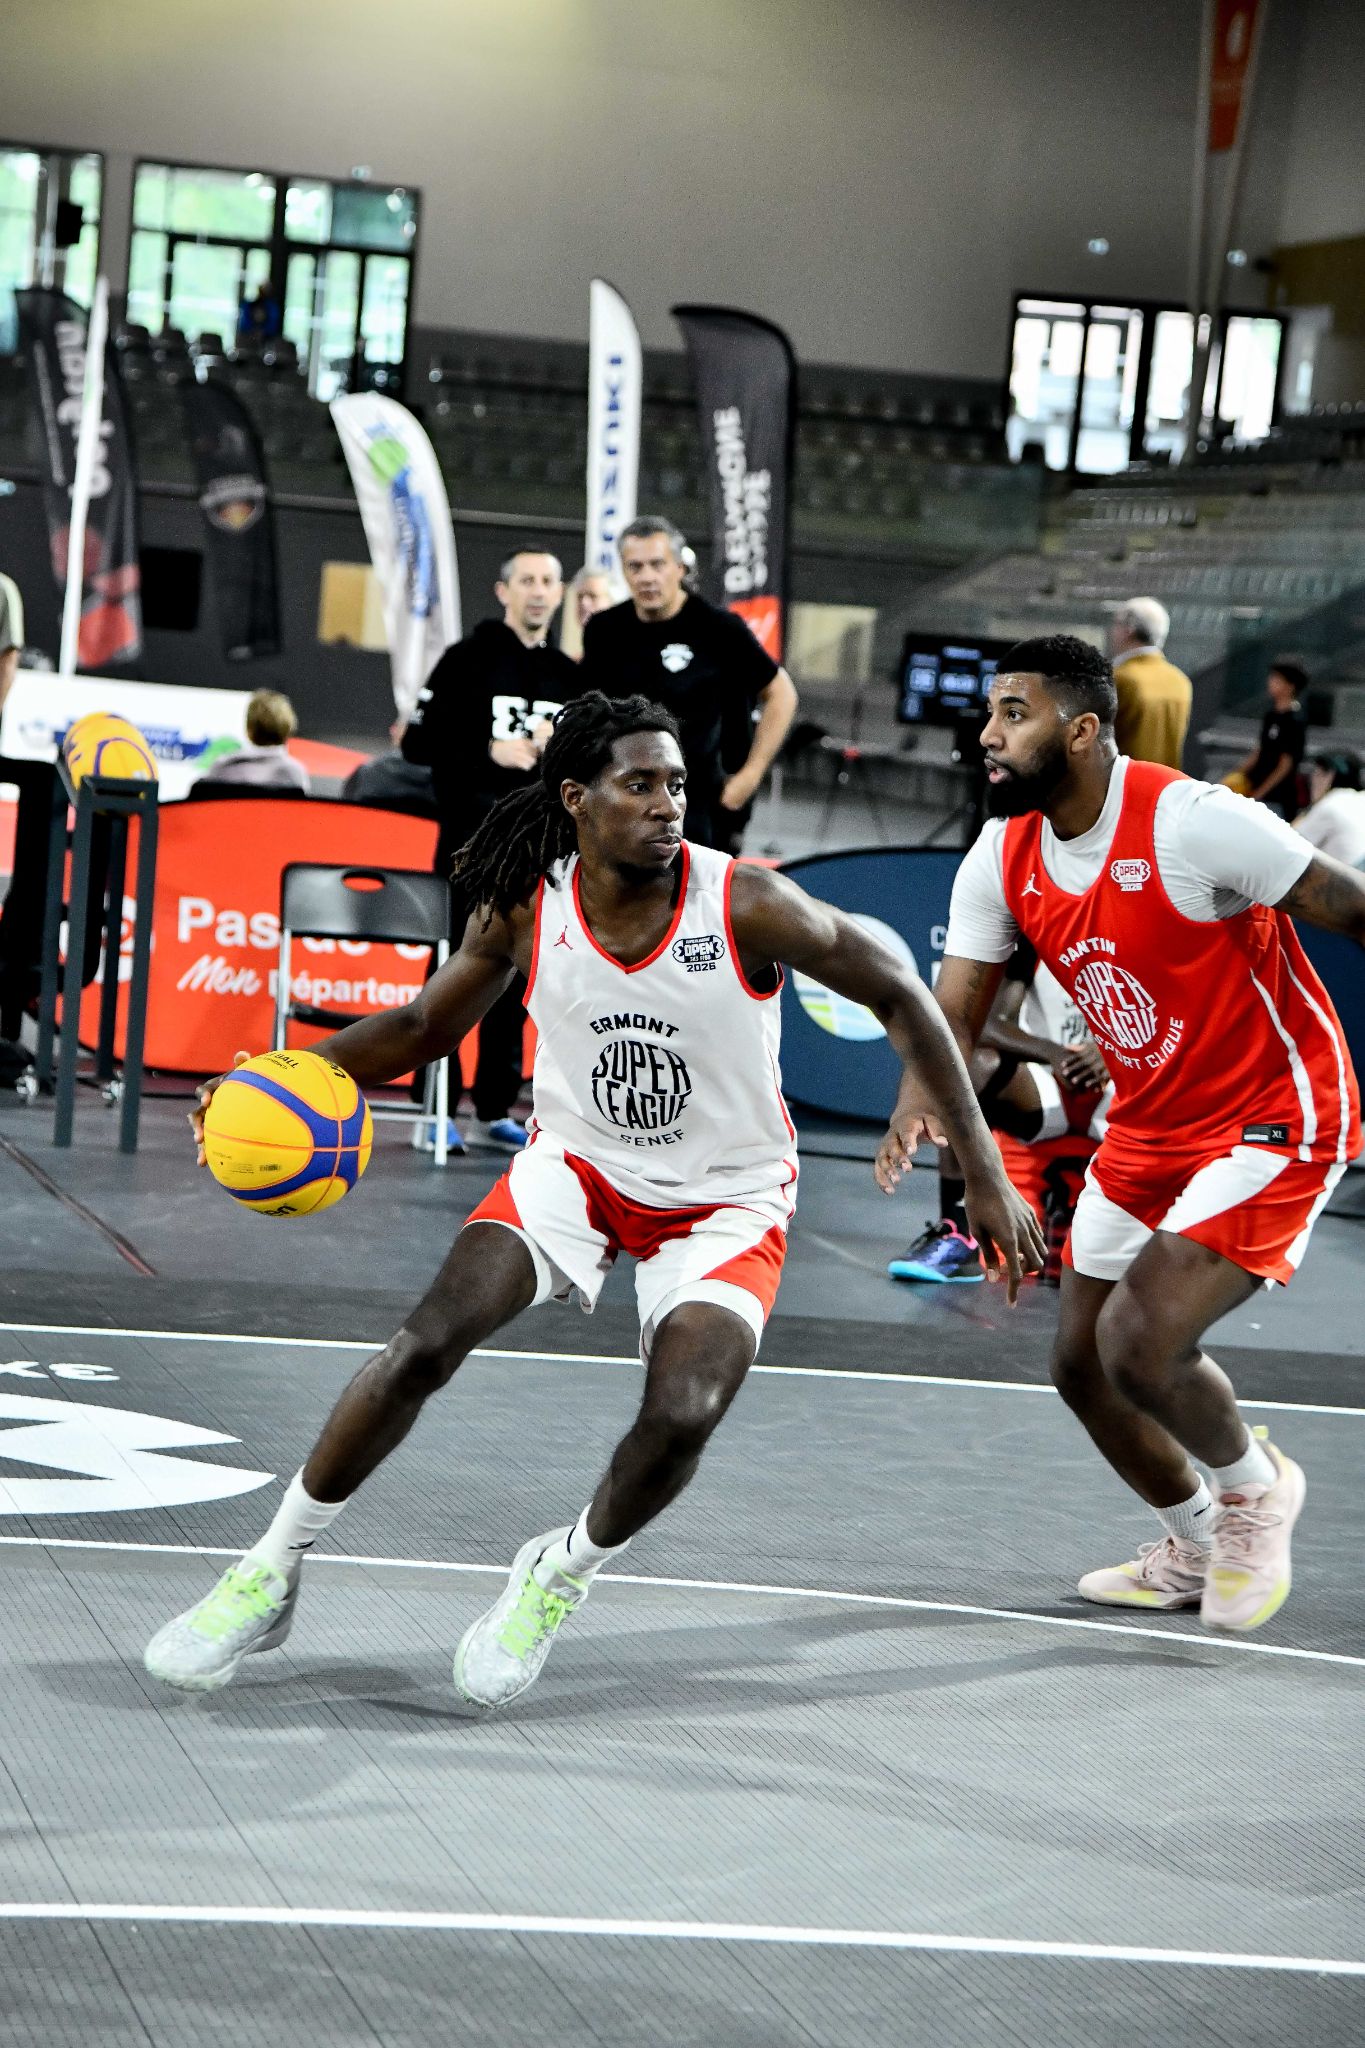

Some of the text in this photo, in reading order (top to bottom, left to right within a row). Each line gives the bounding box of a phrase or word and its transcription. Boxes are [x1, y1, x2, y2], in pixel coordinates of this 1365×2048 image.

[1120, 866, 1141, 876] OPEN
[178, 896, 281, 949] Pas
[684, 942, 715, 957] OPEN
[1059, 937, 1116, 968] PANTIN
[176, 954, 262, 996] Mon
[687, 962, 716, 973] 2026
[1074, 961, 1155, 1011] SUPER
[590, 1012, 680, 1038] ERMONT
[1081, 1001, 1158, 1049] LEAGUE
[592, 1040, 692, 1095] SUPER
[1094, 1033, 1142, 1070] SPORT
[592, 1079, 692, 1130] LEAGUE
[620, 1129, 684, 1147] SENEF
[1271, 1129, 1285, 1139] XL
